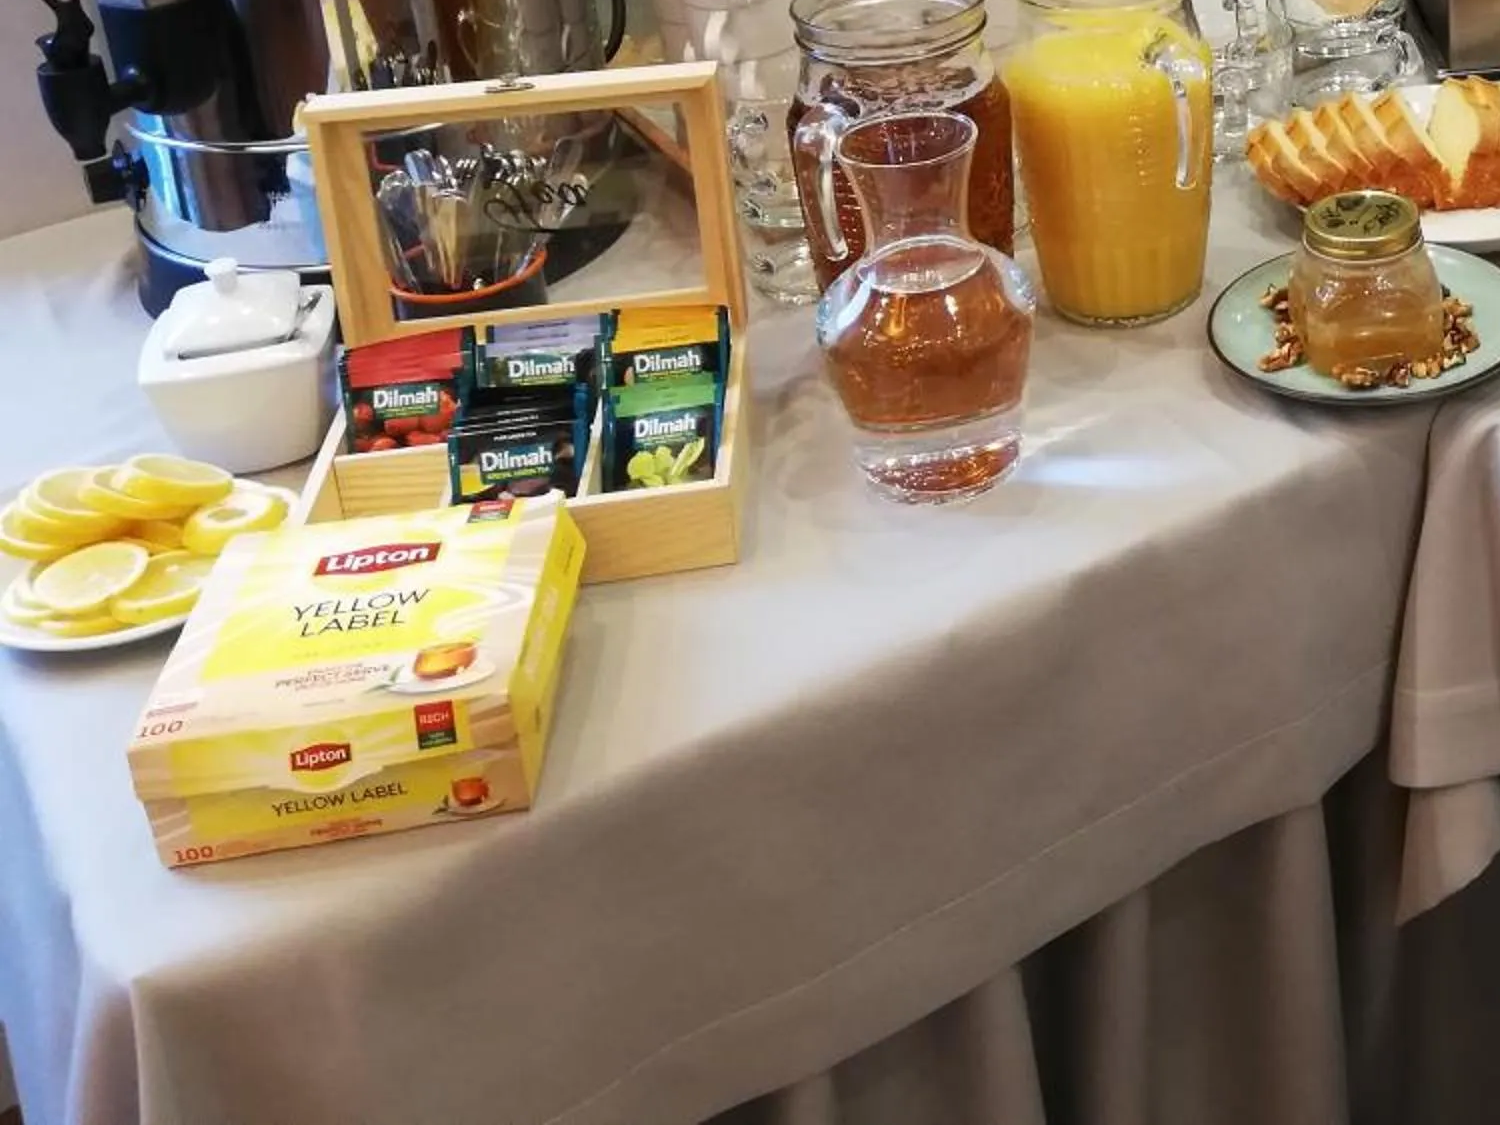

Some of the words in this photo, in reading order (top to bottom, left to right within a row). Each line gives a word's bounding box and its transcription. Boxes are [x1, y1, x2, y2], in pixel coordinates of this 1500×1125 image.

[507, 355, 575, 378] Dilmah
[634, 350, 701, 374] Dilmah
[372, 386, 438, 409] Dilmah
[634, 413, 696, 438] Dilmah
[480, 445, 553, 472] Dilmah
[325, 544, 430, 572] Lipton
[293, 588, 431, 621] YELLOW
[300, 610, 406, 637] LABEL
[137, 719, 185, 739] 100
[295, 747, 347, 767] Lipton
[271, 793, 345, 817] YELLOW
[351, 781, 409, 804] LABEL
[175, 845, 213, 864] 100
